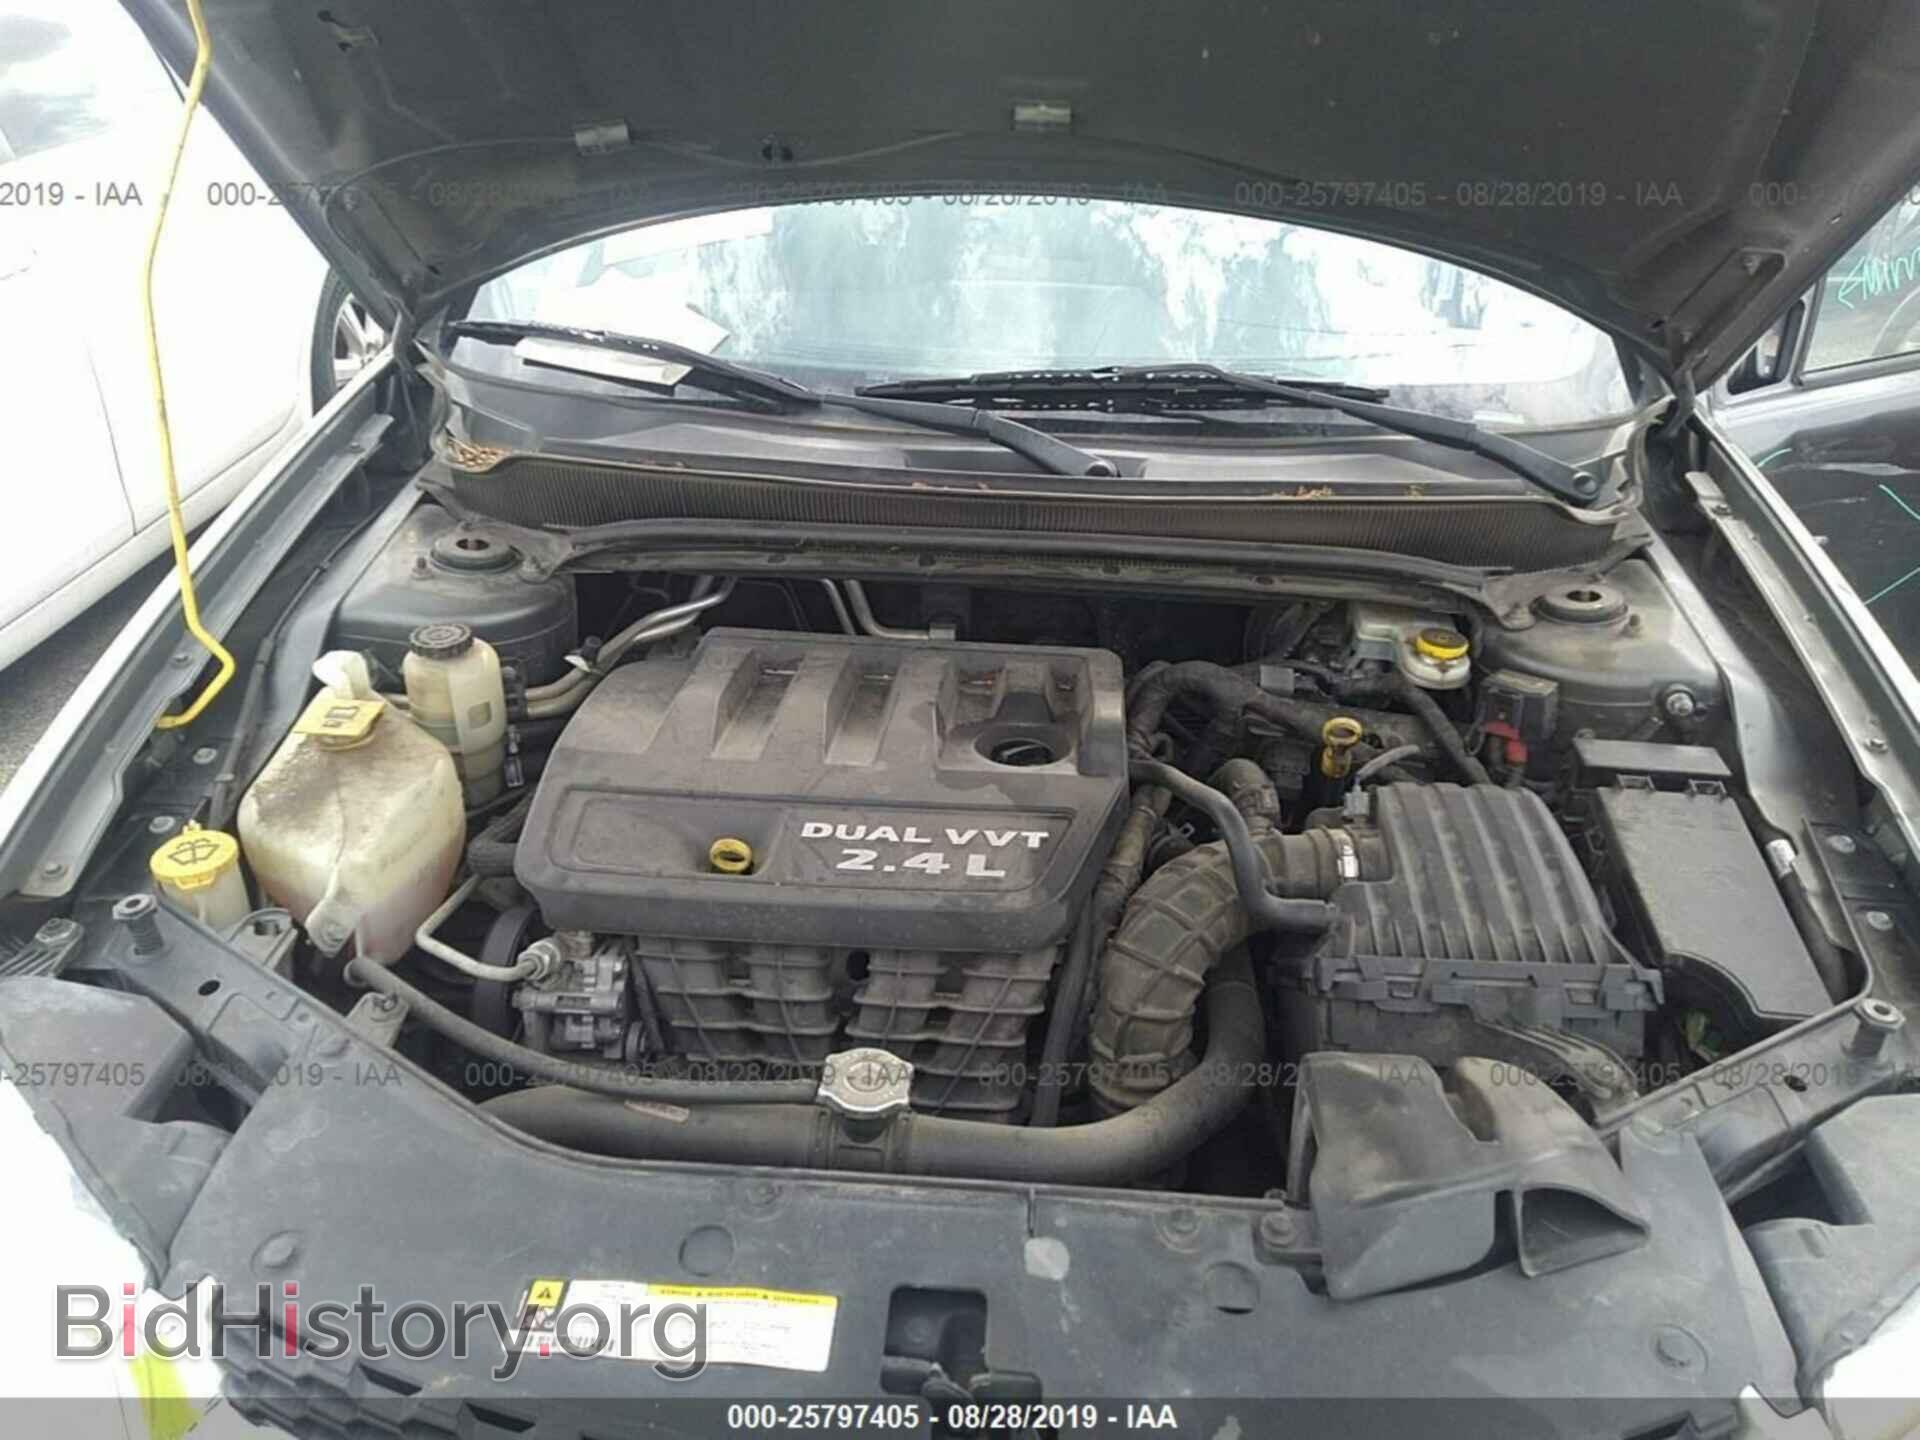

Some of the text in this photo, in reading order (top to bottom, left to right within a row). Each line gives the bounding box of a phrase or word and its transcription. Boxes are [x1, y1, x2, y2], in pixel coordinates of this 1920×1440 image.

[801, 820, 1050, 848] DUAL VVT
[836, 849, 1007, 878] 2.4 L
